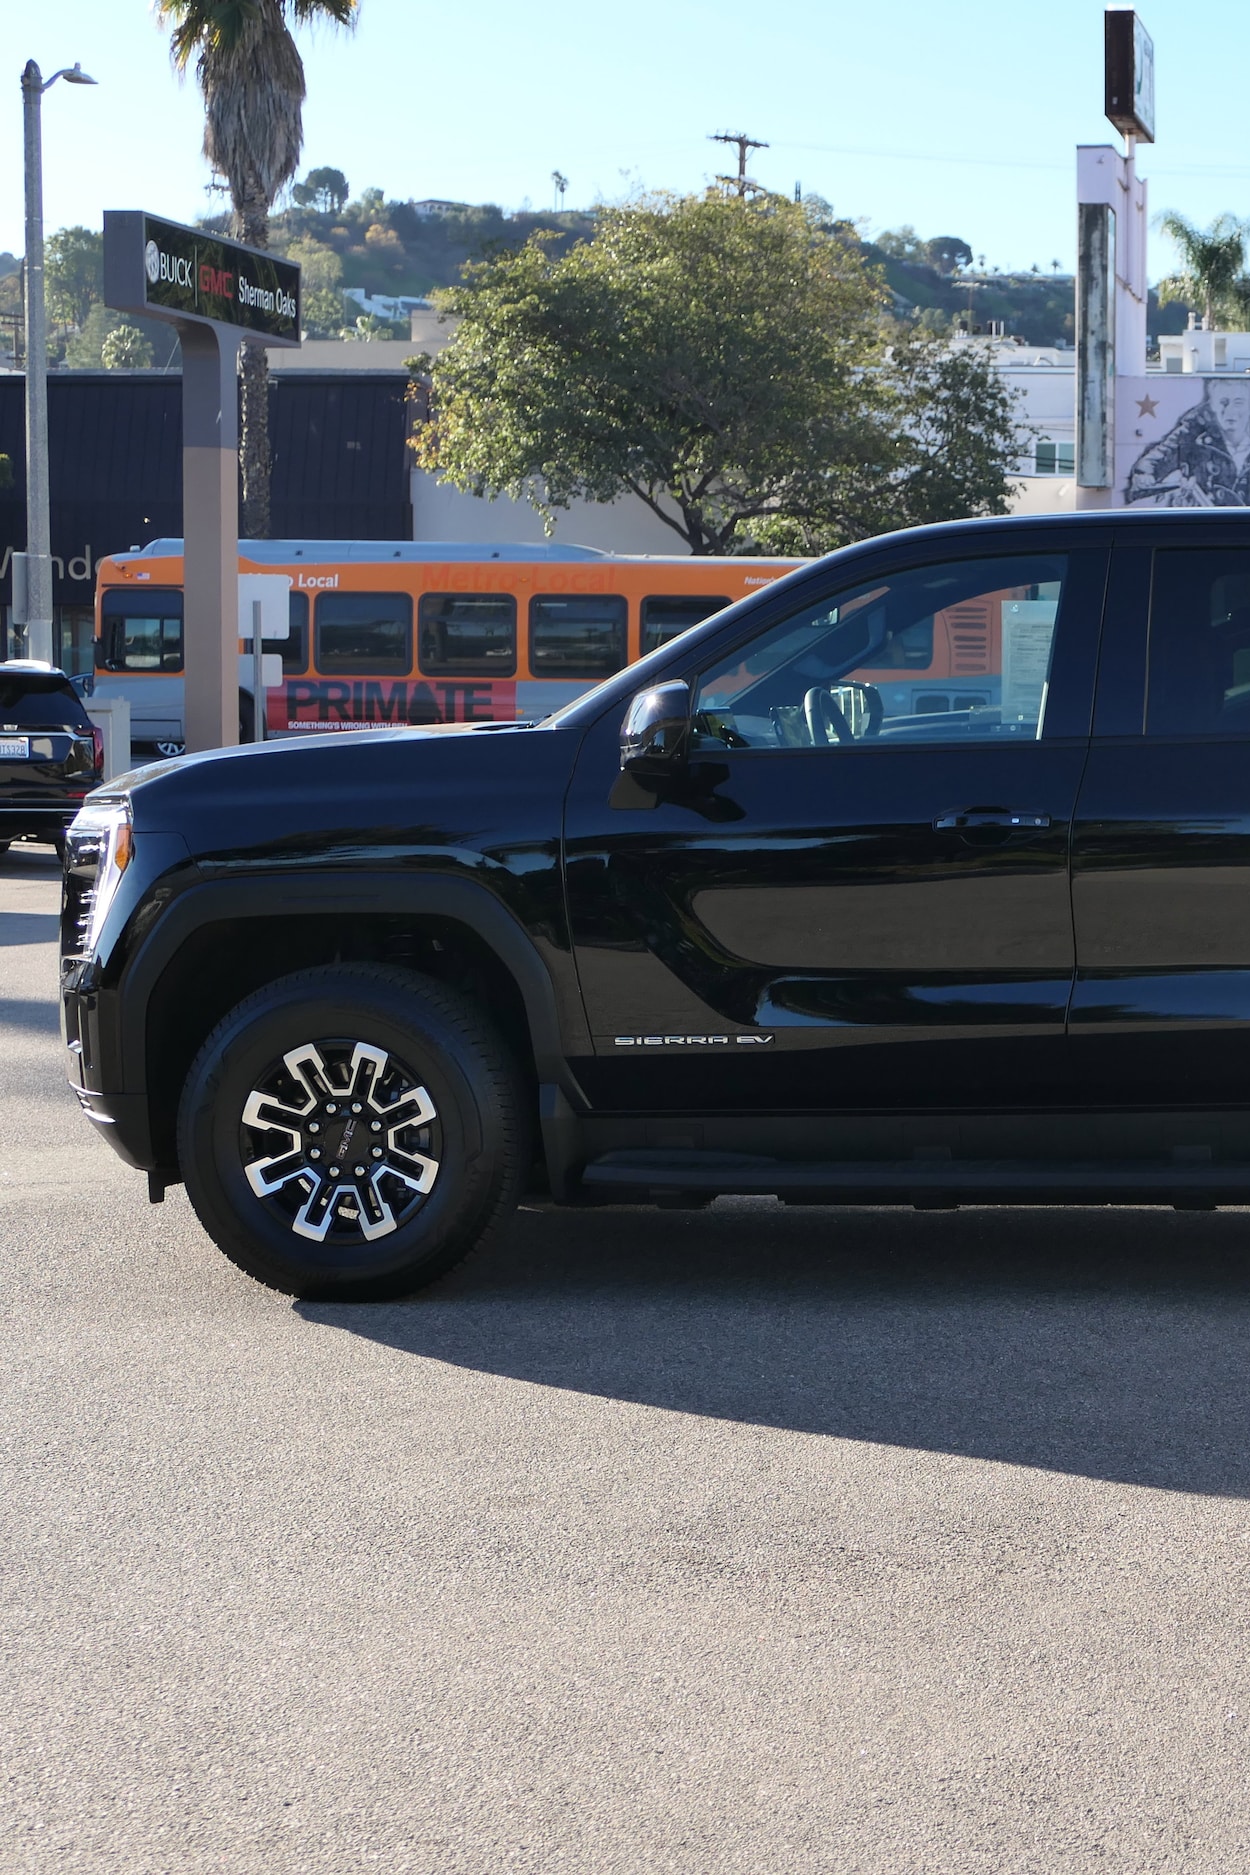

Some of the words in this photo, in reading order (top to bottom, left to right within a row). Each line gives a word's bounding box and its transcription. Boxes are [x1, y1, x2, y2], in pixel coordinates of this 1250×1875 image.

[160, 252, 192, 288] BUICK
[199, 265, 233, 298] GMC
[238, 276, 274, 311] Sherman
[276, 288, 296, 318] Oaks
[298, 572, 339, 588] Local
[420, 564, 518, 591] Metro
[531, 566, 616, 592] Local
[288, 720, 340, 730] SOMETHING'S
[341, 721, 370, 730] WRONG
[614, 1036, 729, 1046] SIERRA
[736, 1035, 774, 1045] EV
